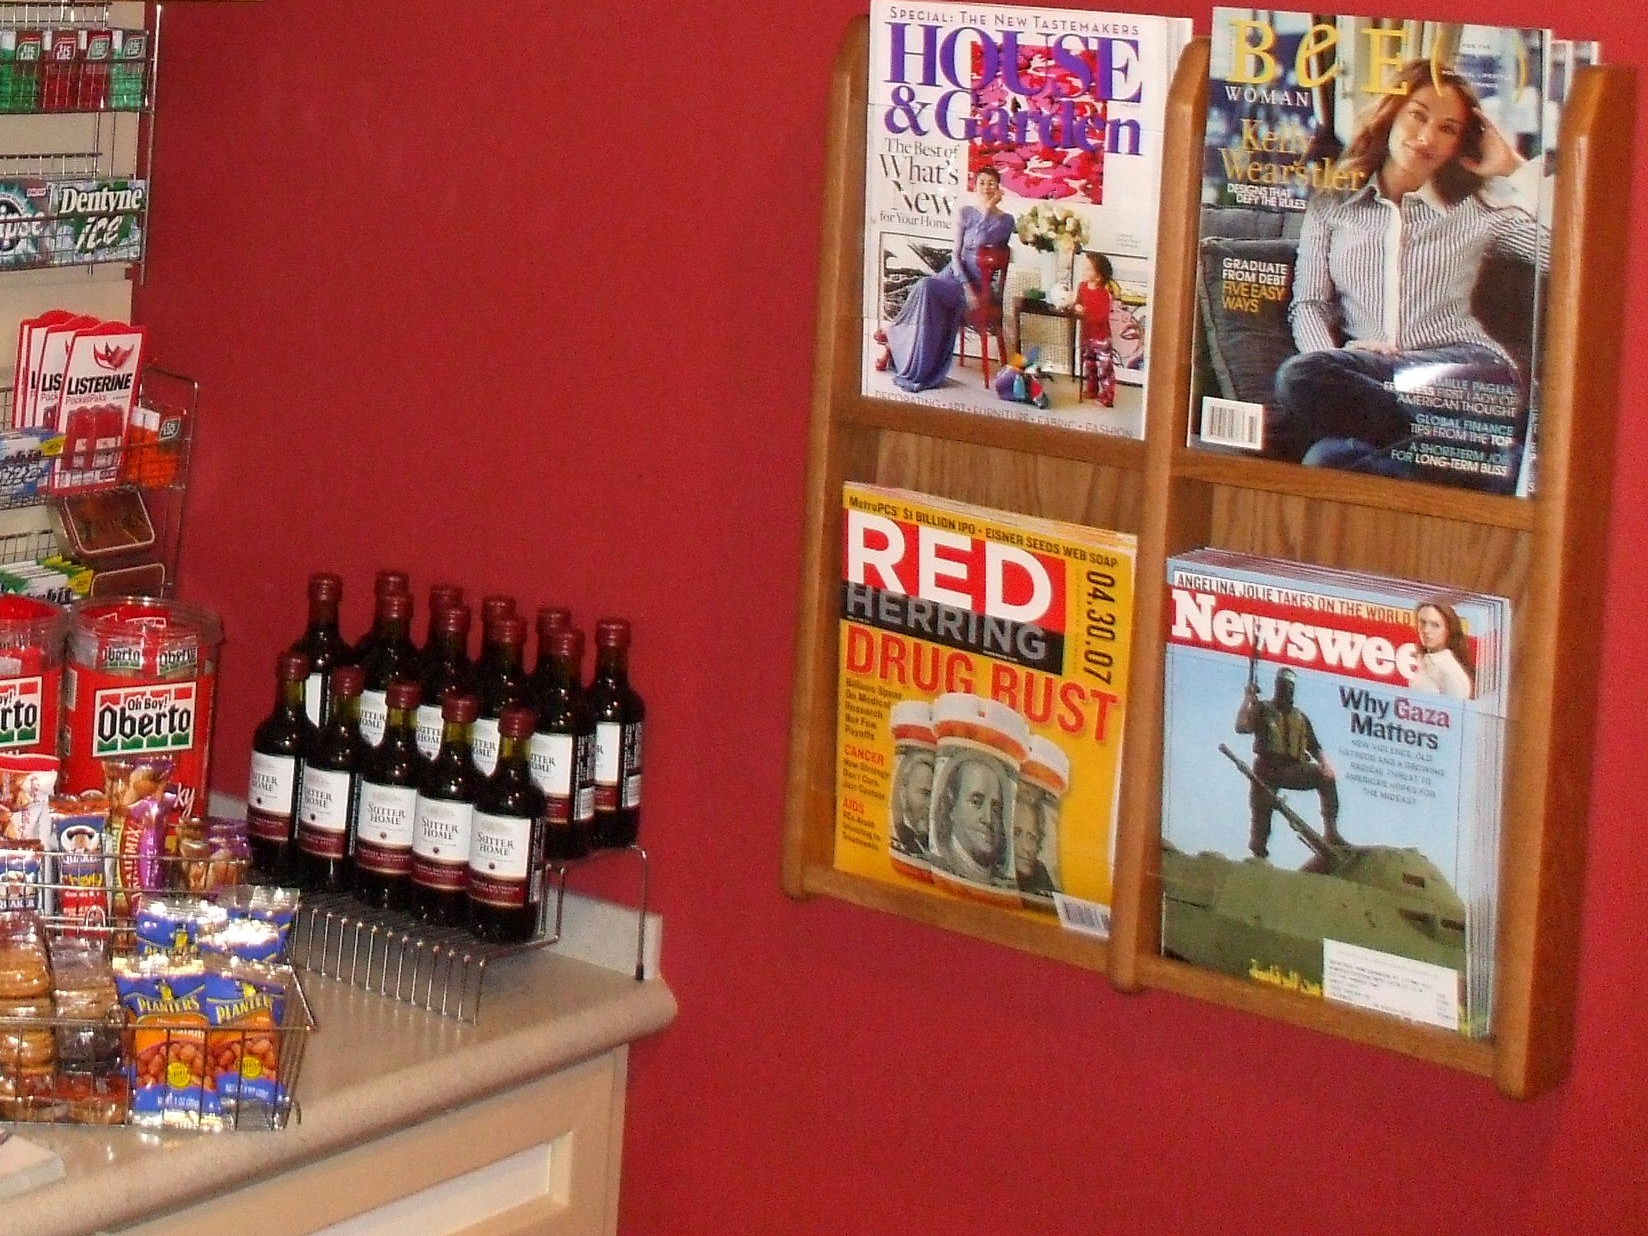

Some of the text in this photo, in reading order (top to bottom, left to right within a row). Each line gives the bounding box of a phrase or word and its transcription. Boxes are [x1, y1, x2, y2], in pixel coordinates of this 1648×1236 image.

[890, 6, 1139, 36] SPECIAL: THE NEW TASTEMAKERS
[884, 22, 1143, 103] HOUSE
[1225, 86, 1309, 107] WOMAN
[885, 138, 912, 154] The
[915, 141, 941, 157] Best
[879, 154, 959, 186] What's
[59, 187, 143, 214] Dentyne
[921, 216, 952, 230] Home
[1222, 258, 1287, 274] GRADUATE
[1222, 270, 1286, 286] FROM DEBT
[67, 372, 133, 395] LISTERINE
[915, 511, 976, 535] BILLION IPO
[985, 527, 1118, 568] EISNER SEEDS WEB SOAP
[848, 510, 1052, 623] RED
[1177, 573, 1412, 625] ANGELINA JOLIE TAKES ON THE WORLD
[846, 585, 1047, 660] HERRING
[1083, 569, 1116, 686] 04.30.07
[1172, 588, 1419, 677] Newswee
[846, 624, 1118, 741] DRUG BUST
[128, 696, 169, 711] Oh Boy!
[1339, 685, 1450, 729] Why Gaza
[98, 705, 190, 741] Oberto
[1351, 711, 1439, 750] Matters
[368, 802, 405, 818] SUTTER
[370, 814, 400, 825] HOME
[477, 832, 514, 849] SUTTER
[479, 844, 508, 856] HOME
